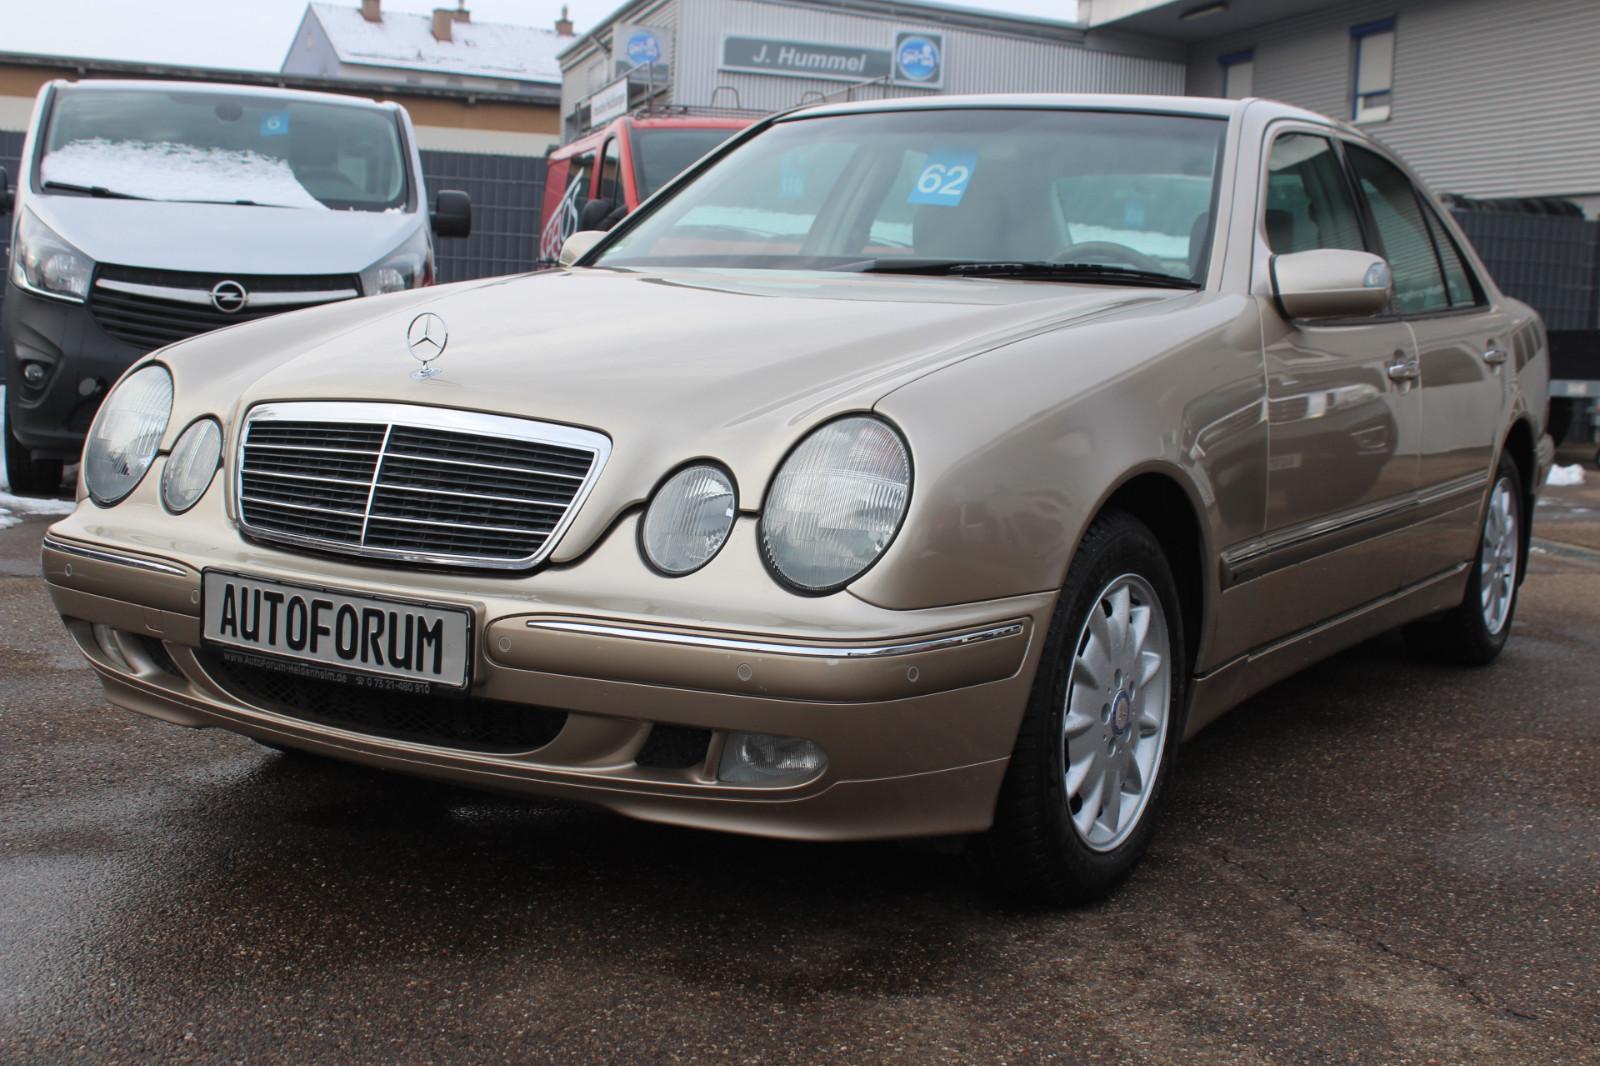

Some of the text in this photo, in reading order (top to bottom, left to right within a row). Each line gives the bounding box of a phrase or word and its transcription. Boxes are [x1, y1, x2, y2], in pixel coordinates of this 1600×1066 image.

[752, 44, 867, 72] J. Hummel
[918, 164, 969, 194] 62
[220, 583, 443, 675] AUTOFORUM
